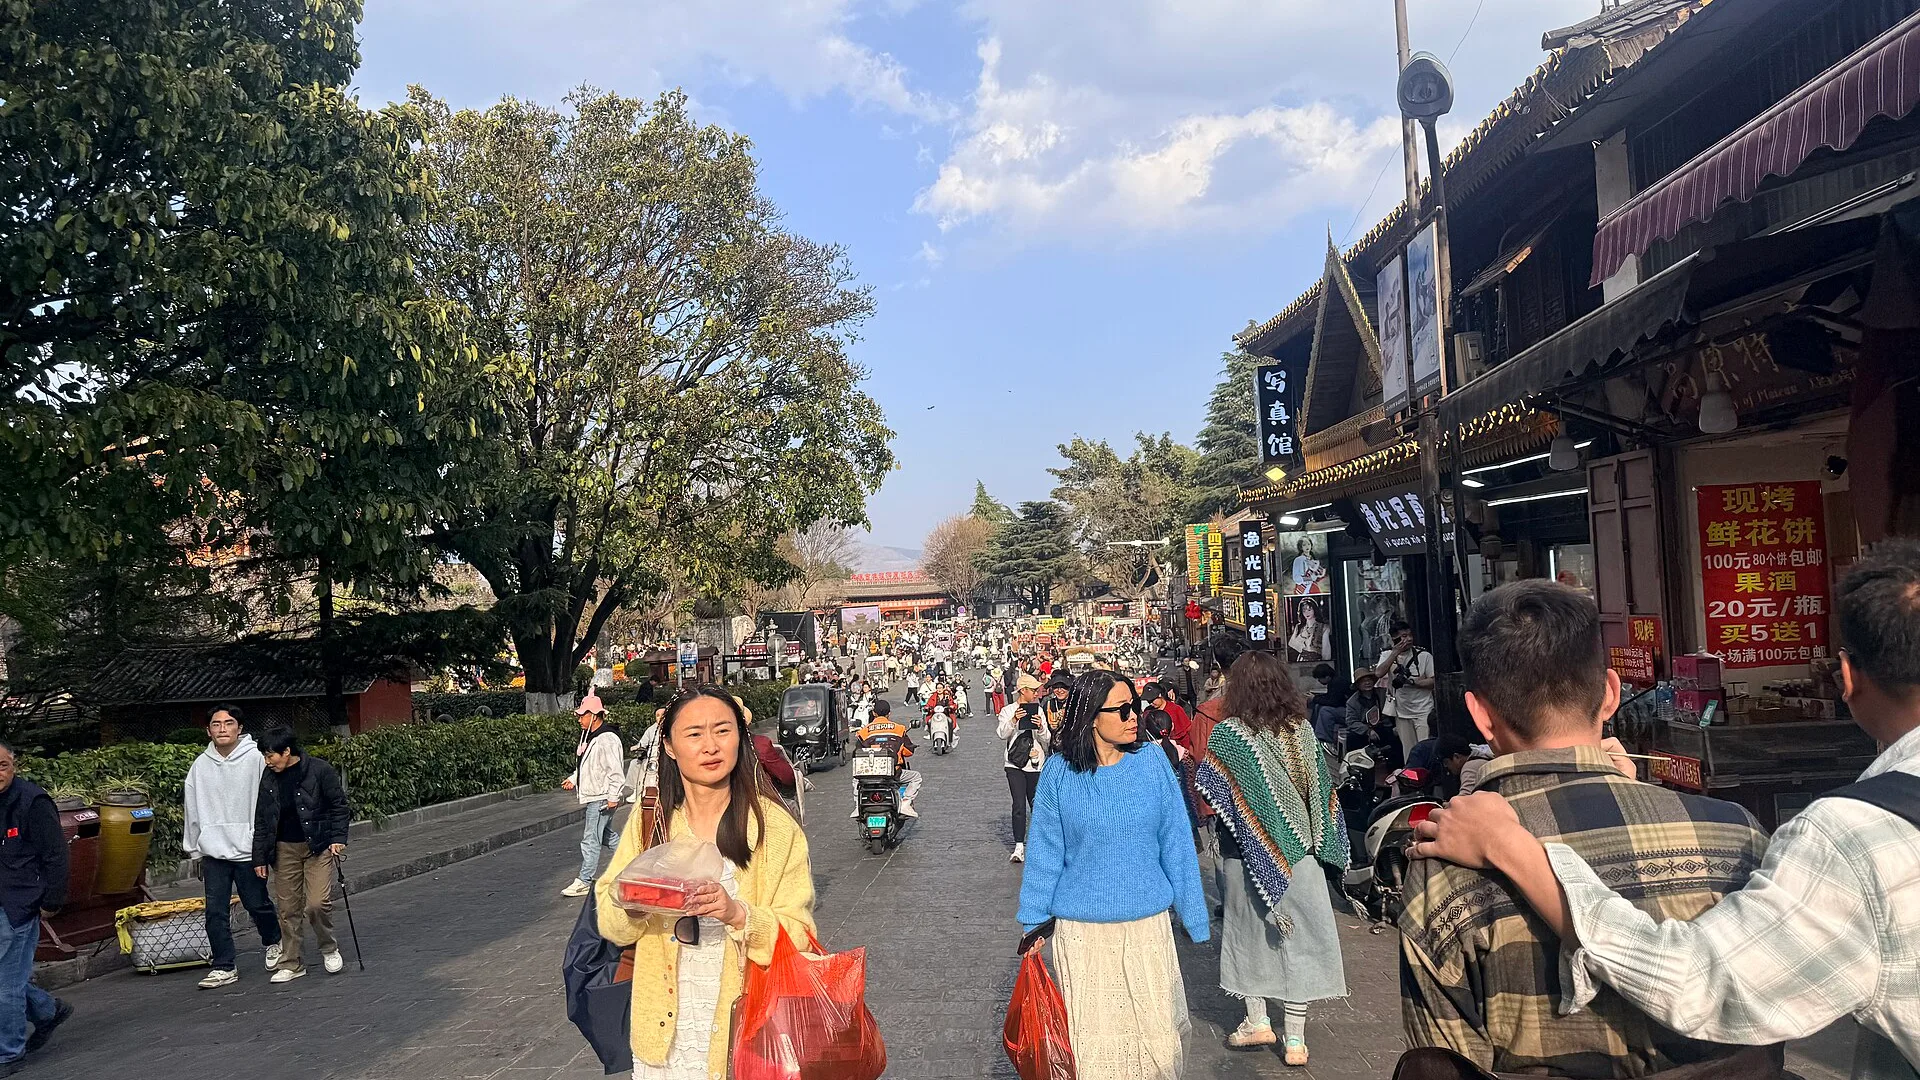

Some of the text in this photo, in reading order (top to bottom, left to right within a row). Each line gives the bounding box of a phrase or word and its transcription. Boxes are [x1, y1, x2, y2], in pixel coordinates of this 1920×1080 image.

[1265, 370, 1293, 456] 写真馆
[1722, 486, 1795, 514] 现烤
[1706, 517, 1816, 547] 鲜花饼
[1208, 533, 1223, 597] 四方街超市
[1243, 531, 1267, 641] 逸光写真馆
[1734, 571, 1797, 593] 果酒
[1709, 595, 1826, 618] 20元/瓶
[1634, 620, 1654, 641] 现烤
[1720, 621, 1817, 644] 买5送1
[1715, 645, 1827, 663] 全场满100元包邮
